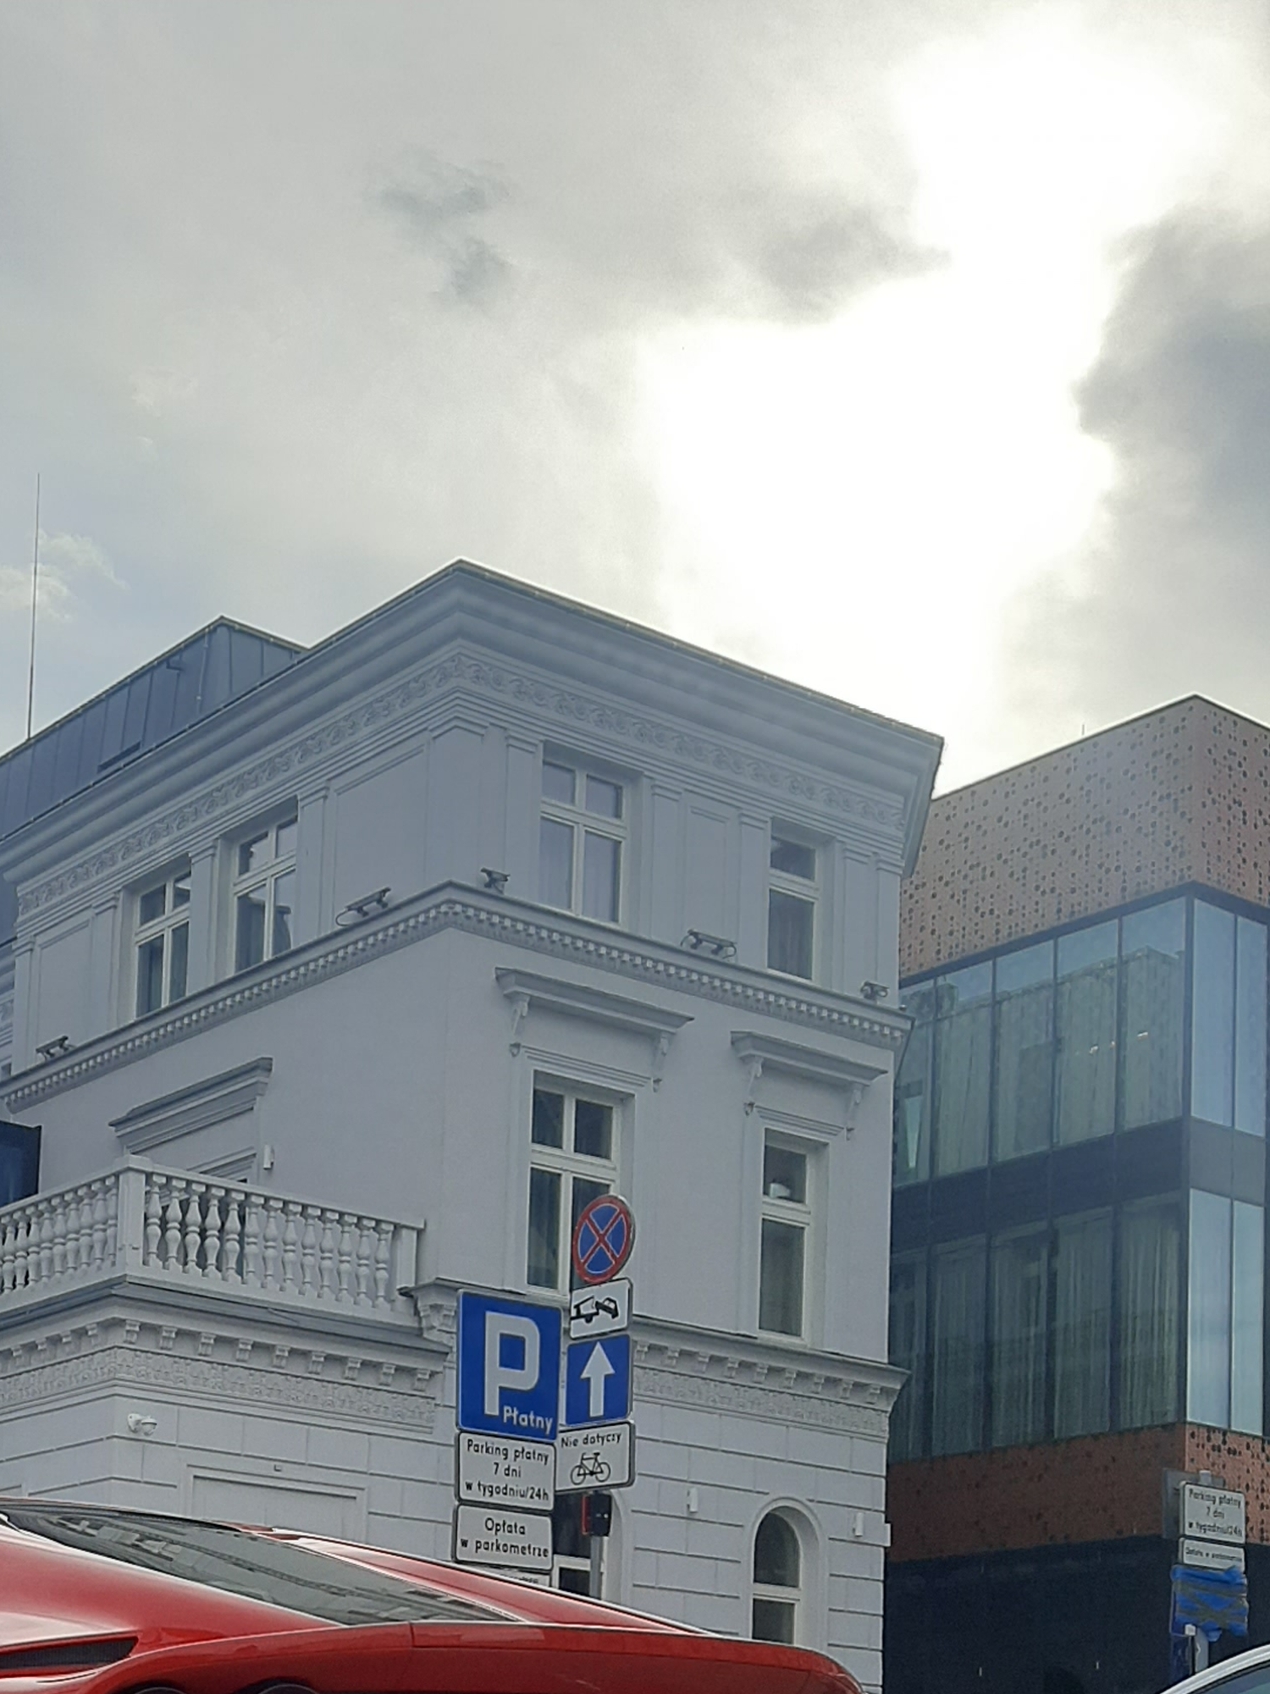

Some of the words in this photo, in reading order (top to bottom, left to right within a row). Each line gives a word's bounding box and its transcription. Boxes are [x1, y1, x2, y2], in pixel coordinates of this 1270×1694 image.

[484, 1311, 540, 1416] P
[503, 1406, 553, 1435] Płatny
[561, 1436, 579, 1448] Nie
[582, 1432, 622, 1447] dotyczy
[467, 1439, 508, 1460] Parking
[513, 1447, 550, 1465] płatny
[493, 1463, 499, 1475] 7
[504, 1464, 522, 1478] dni
[465, 1481, 473, 1491] w
[478, 1480, 549, 1501] tygodniu/24h
[485, 1517, 526, 1536] Opłata
[461, 1539, 469, 1548] w
[475, 1539, 549, 1557] parkometrze
